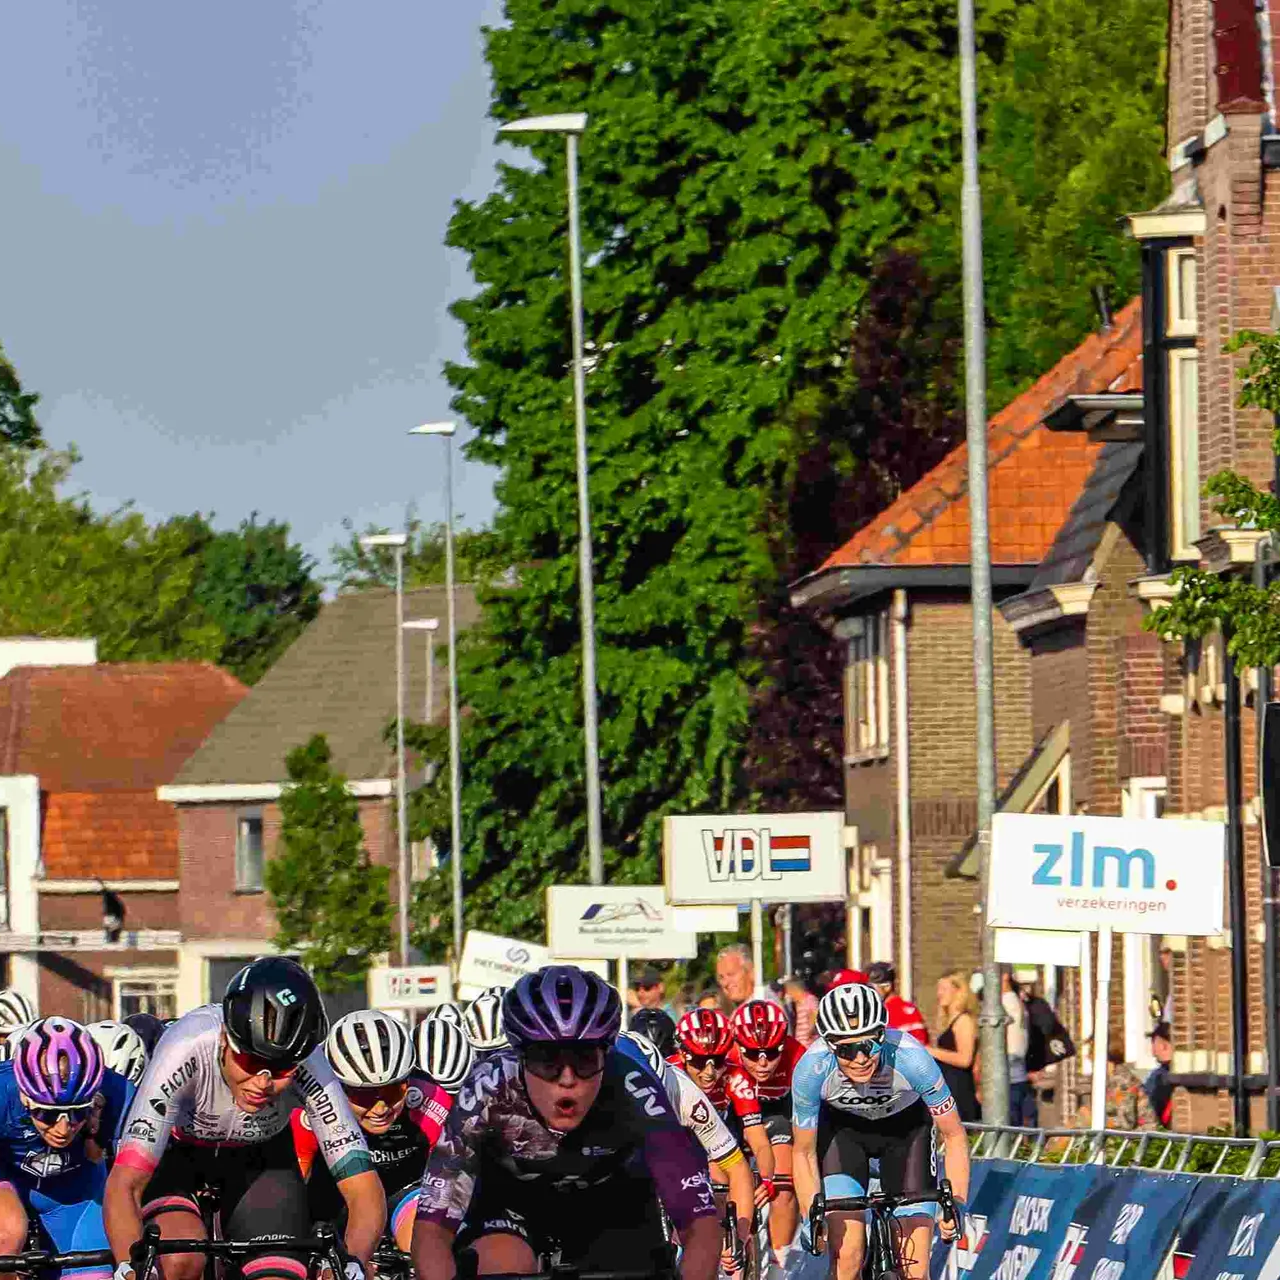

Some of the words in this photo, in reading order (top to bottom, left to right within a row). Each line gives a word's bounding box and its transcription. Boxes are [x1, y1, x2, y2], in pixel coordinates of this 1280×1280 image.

[701, 828, 783, 882] VDL
[1057, 896, 1167, 914] verzekeringen
[160, 1056, 199, 1099] FACTOR
